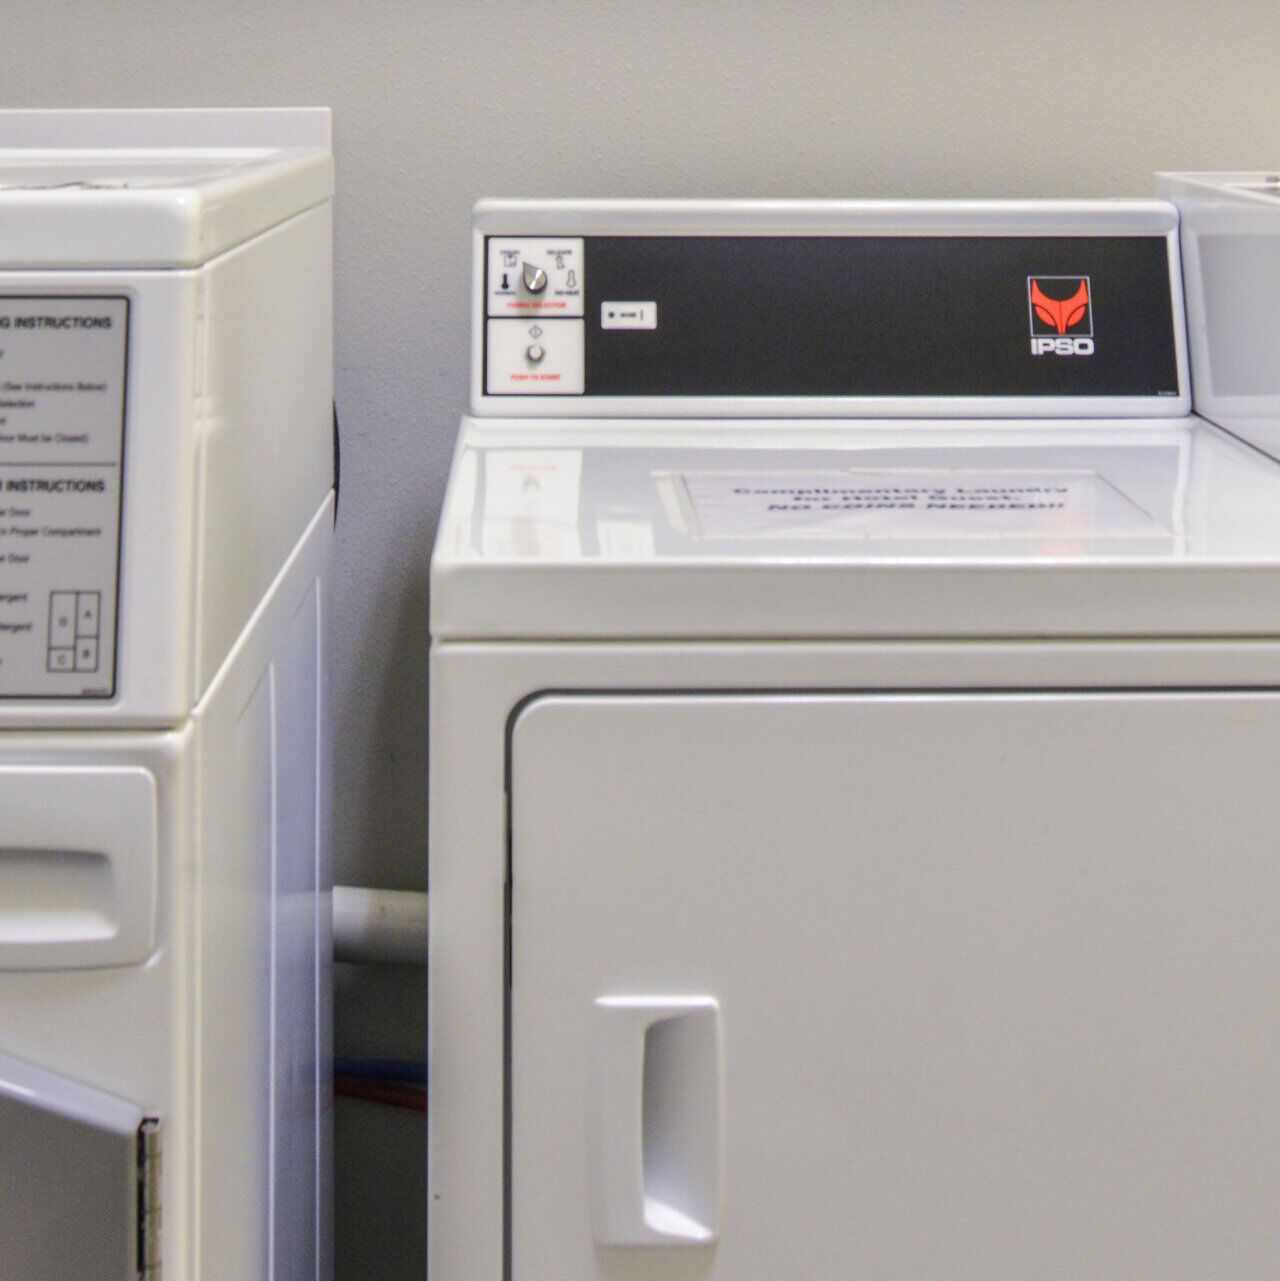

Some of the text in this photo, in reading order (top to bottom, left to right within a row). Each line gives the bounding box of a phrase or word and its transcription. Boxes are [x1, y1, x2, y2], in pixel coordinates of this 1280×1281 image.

[14, 316, 112, 329] INSTRUCTIONS
[1031, 338, 1095, 355] IPSO
[6, 479, 105, 492] INSTRUCTIONS
